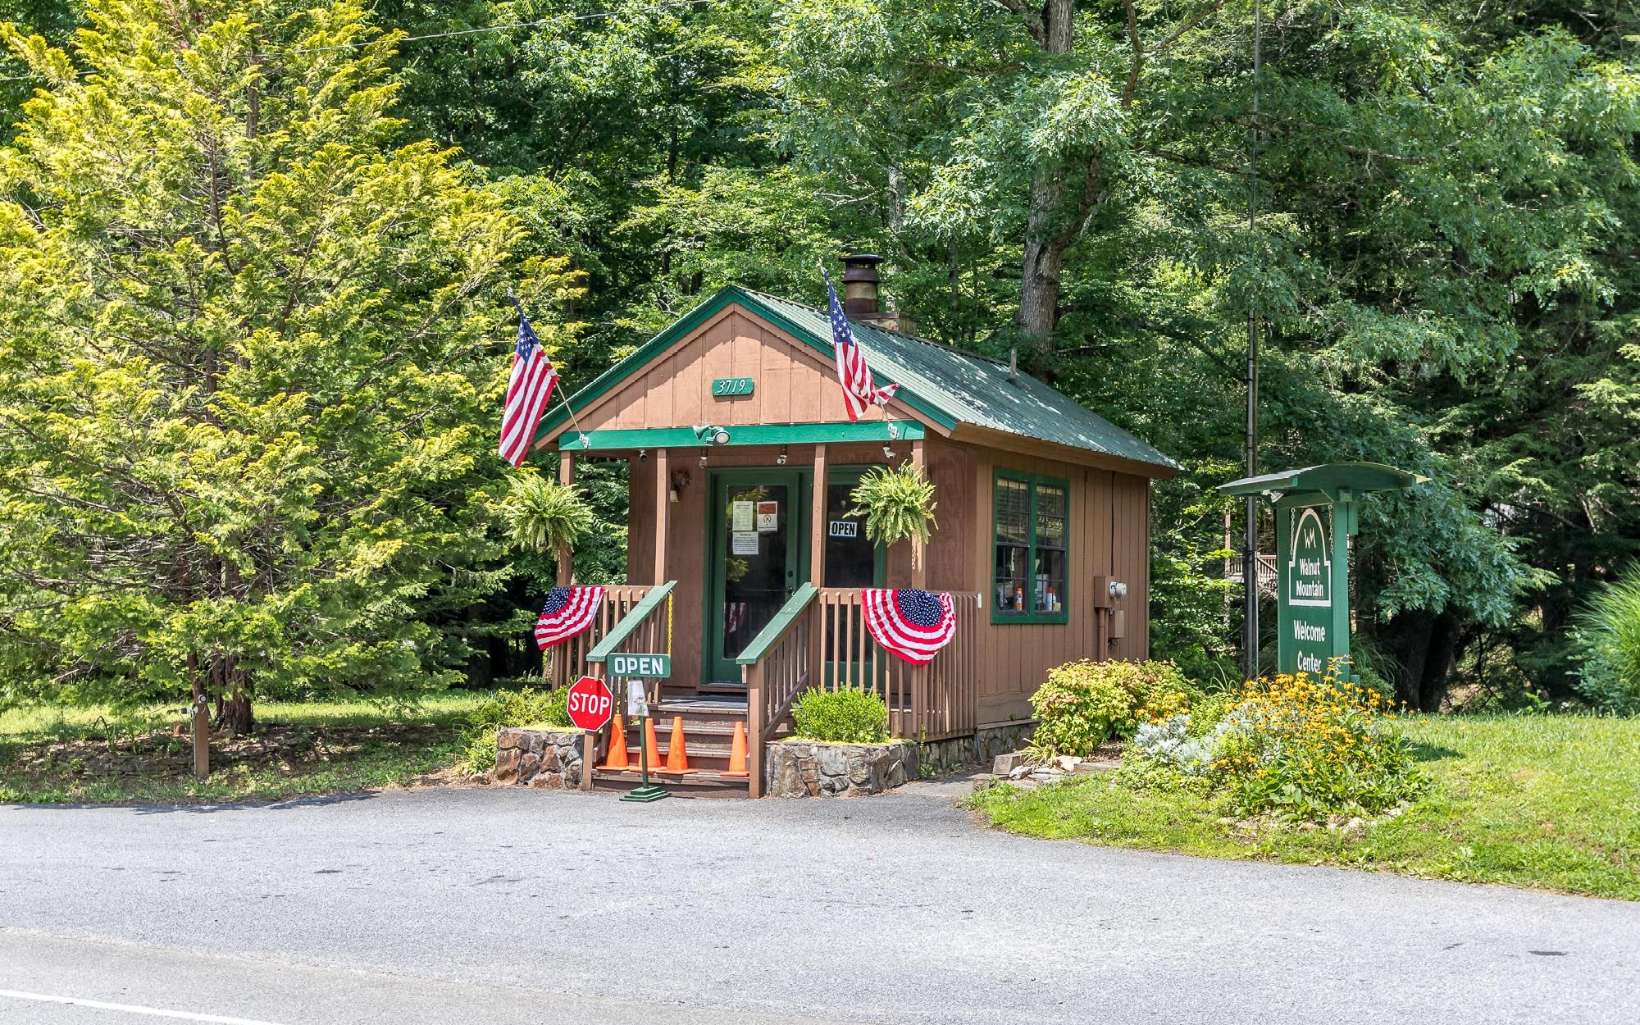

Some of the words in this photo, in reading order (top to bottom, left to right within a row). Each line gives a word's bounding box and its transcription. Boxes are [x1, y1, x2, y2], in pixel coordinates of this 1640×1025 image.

[717, 379, 746, 393] 3719
[831, 522, 855, 535] OPEN
[1299, 557, 1321, 576] Walnut
[1295, 580, 1324, 597] Mountain
[1293, 619, 1326, 642] Welcome
[614, 657, 664, 675] OPEN
[1297, 650, 1322, 673] Center
[569, 692, 610, 715] STOP
